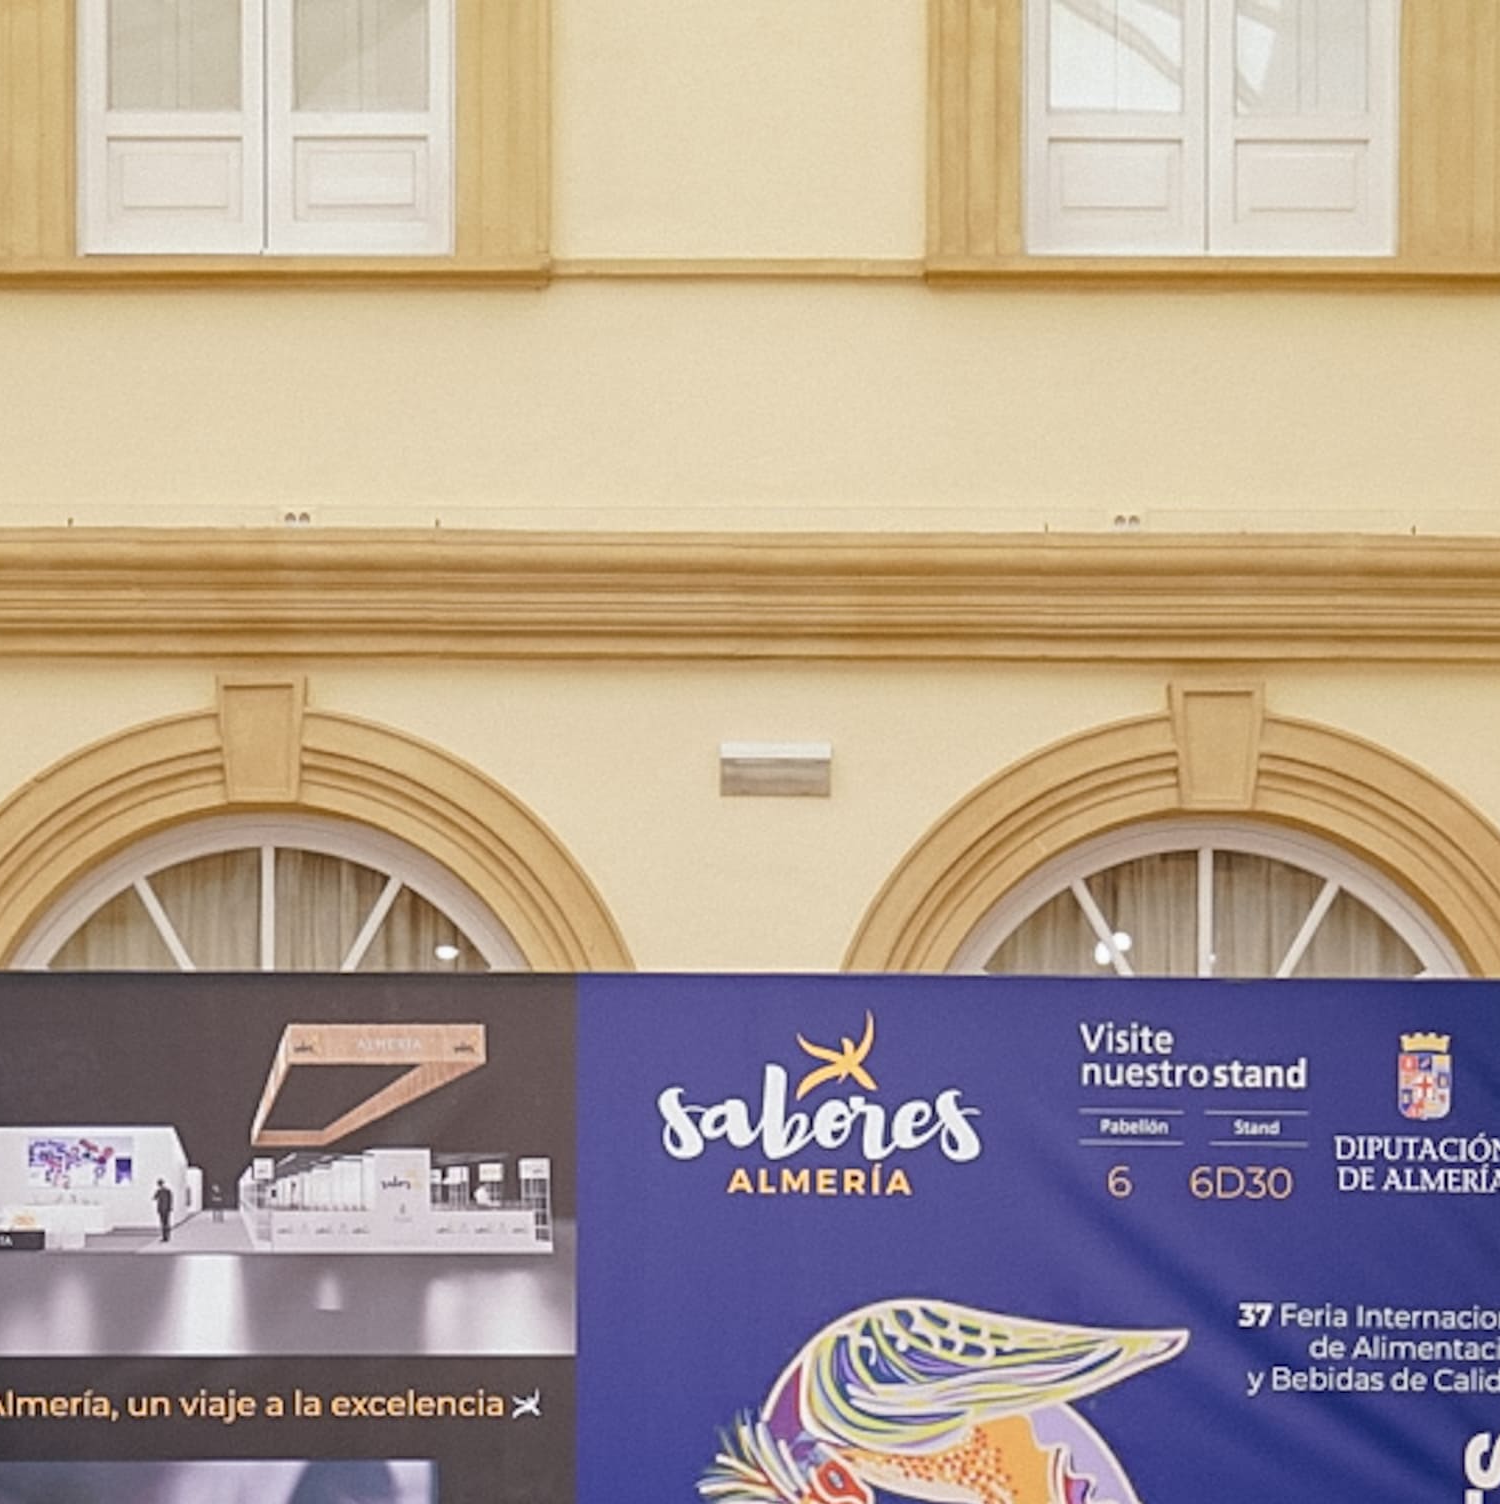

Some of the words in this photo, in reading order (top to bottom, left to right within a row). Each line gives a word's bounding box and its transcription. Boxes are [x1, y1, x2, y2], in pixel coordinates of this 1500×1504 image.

[1080, 1022, 1173, 1054] Visite
[1082, 1059, 1209, 1087] nuestro
[1213, 1057, 1307, 1088] stand
[1100, 1118, 1169, 1135] Pabellón
[1233, 1119, 1281, 1135] Stand
[727, 1162, 912, 1195] ALMERÍA
[1108, 1166, 1132, 1197] 6
[1190, 1166, 1293, 1199] 6D30
[1337, 1166, 1375, 1191] DE
[1238, 1302, 1273, 1328] 37
[1280, 1303, 1348, 1328] Feria
[1309, 1335, 1345, 1360] de
[1247, 1371, 1264, 1396] y
[1271, 1366, 1384, 1392] Bebidas
[1390, 1367, 1427, 1391] de
[127, 1396, 170, 1417] un
[179, 1389, 256, 1424] viaje
[265, 1395, 284, 1416] a
[294, 1389, 322, 1416] la
[331, 1389, 504, 1417] excelencia
